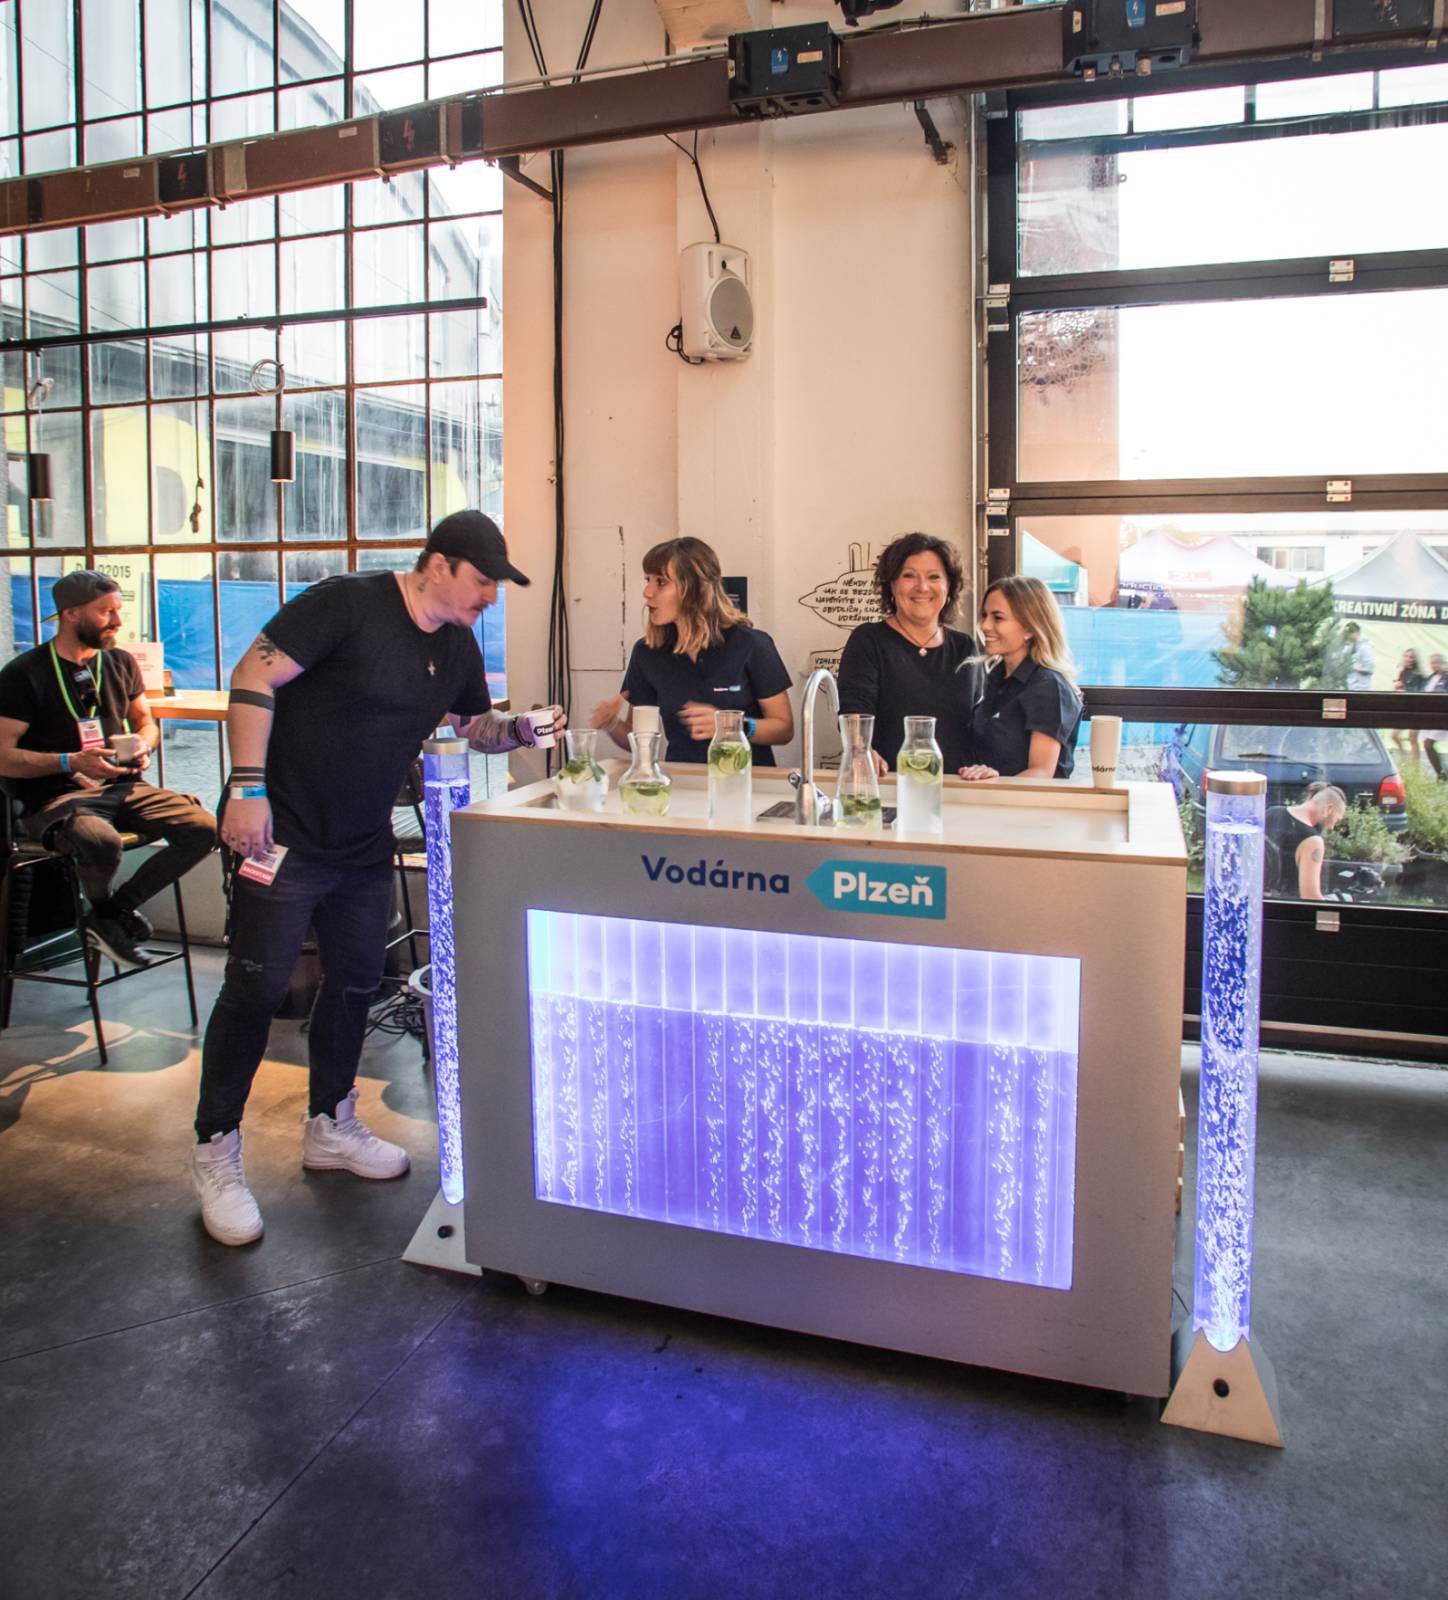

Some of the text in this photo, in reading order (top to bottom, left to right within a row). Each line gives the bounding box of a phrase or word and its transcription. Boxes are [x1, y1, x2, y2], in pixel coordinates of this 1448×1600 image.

[1400, 601, 1437, 619] ZÓNA
[640, 854, 934, 907] Vodárna Plzeň
